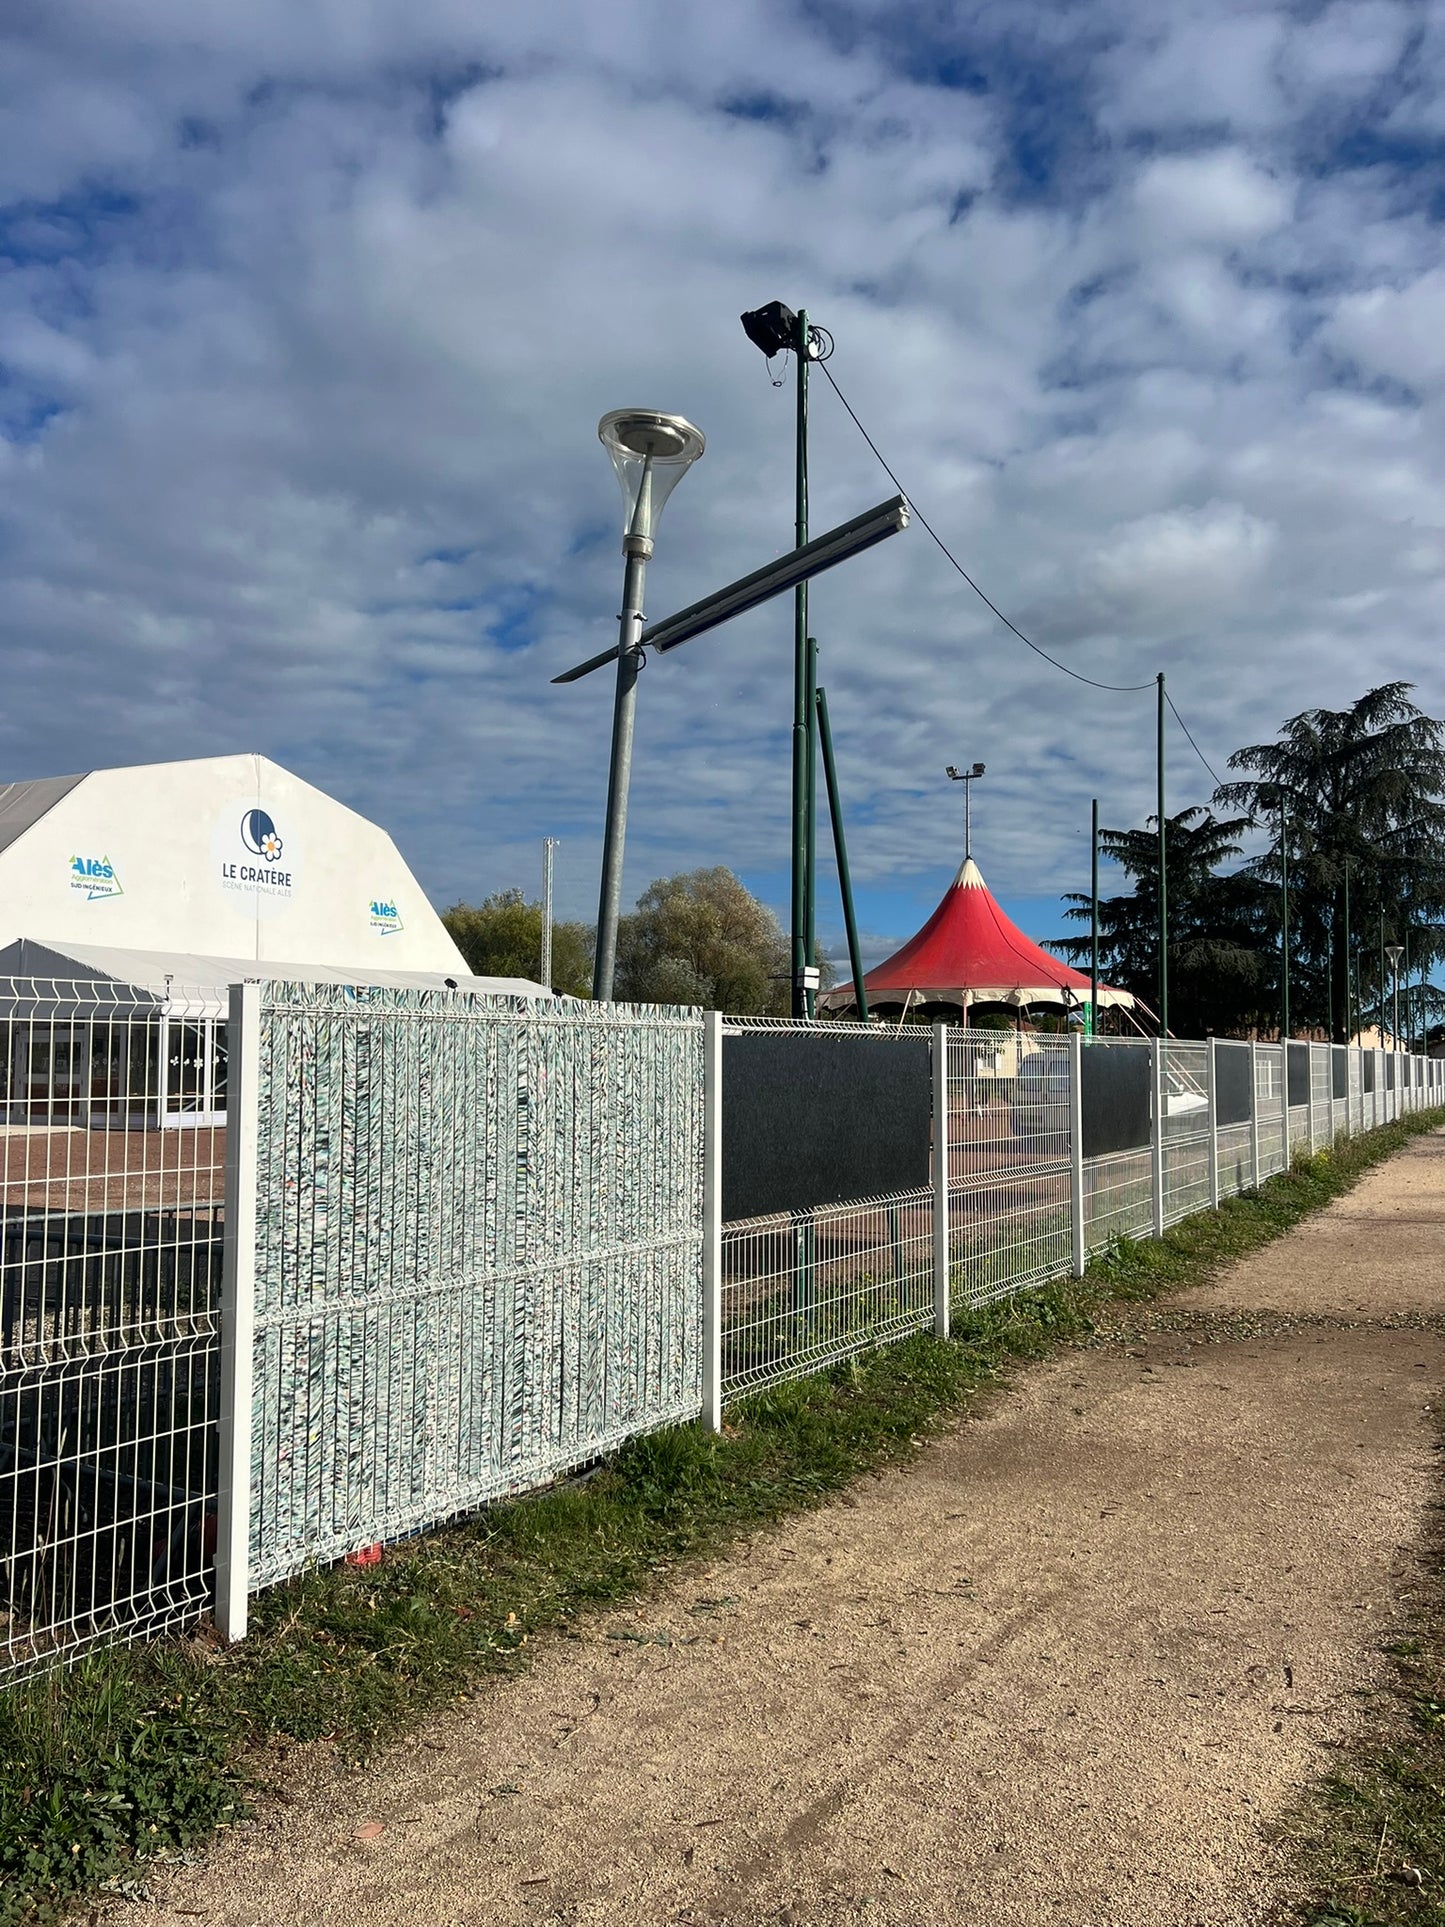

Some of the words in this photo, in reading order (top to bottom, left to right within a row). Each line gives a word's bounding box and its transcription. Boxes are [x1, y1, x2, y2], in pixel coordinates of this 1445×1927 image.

[72, 857, 113, 878] Alès
[222, 863, 237, 879] LE
[240, 866, 291, 887] CRATÈRE
[222, 880, 242, 891] SCÈNE
[244, 884, 276, 895] NATONALE
[371, 901, 397, 917] Alès
